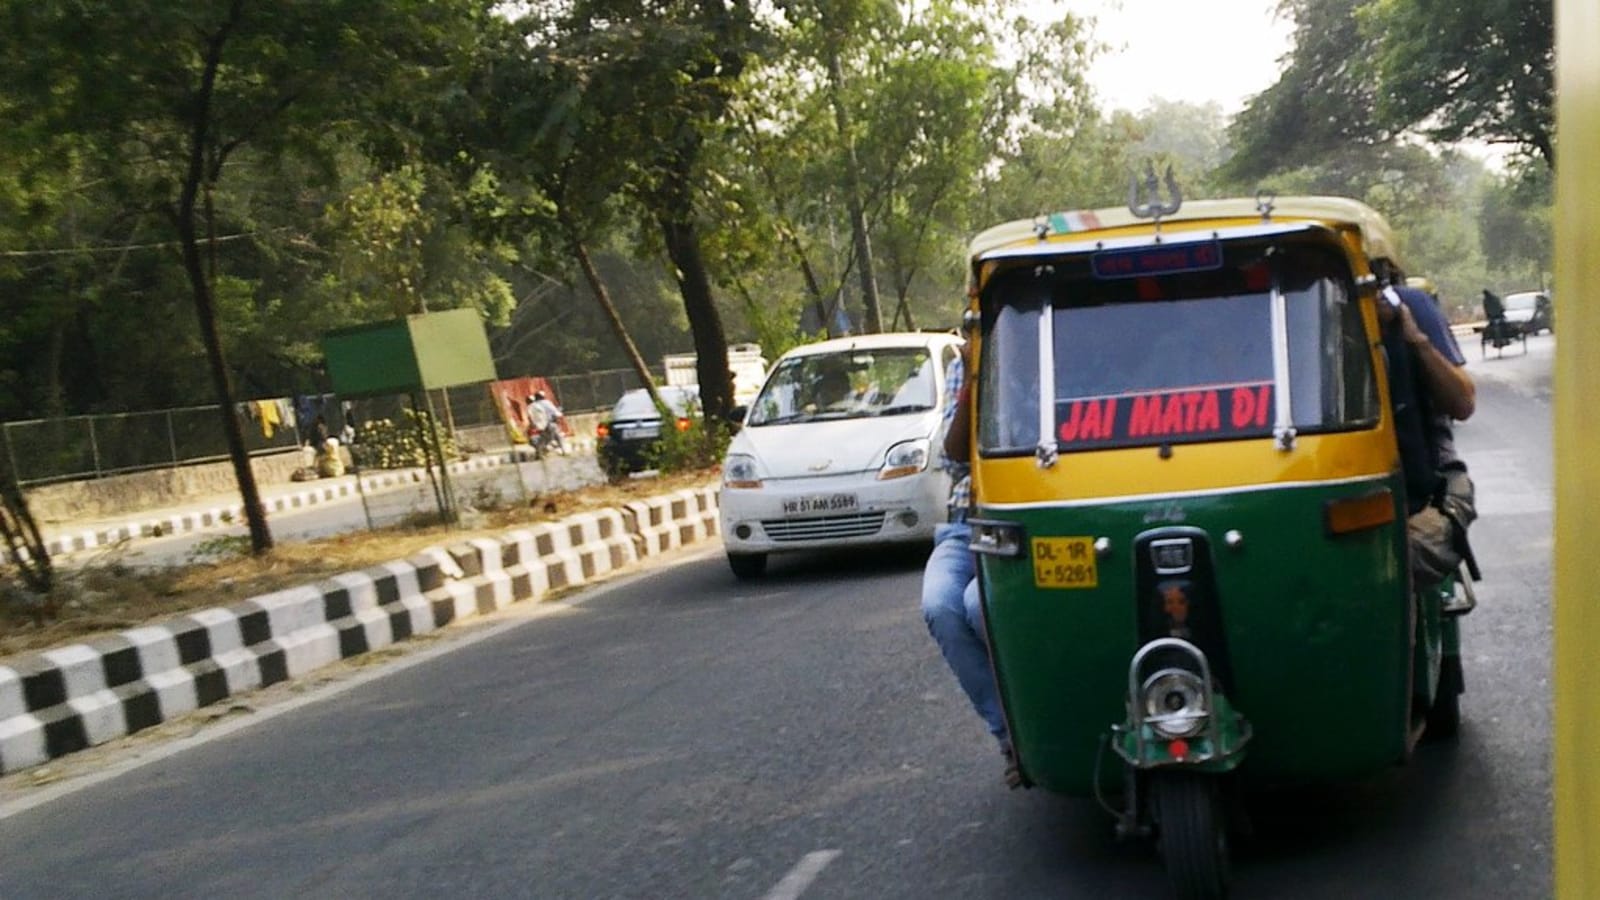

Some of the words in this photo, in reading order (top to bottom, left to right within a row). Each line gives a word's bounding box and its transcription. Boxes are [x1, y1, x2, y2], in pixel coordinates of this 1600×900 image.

[1060, 399, 1117, 442] JAI
[1129, 392, 1219, 437] MATA
[1231, 385, 1272, 428] DI
